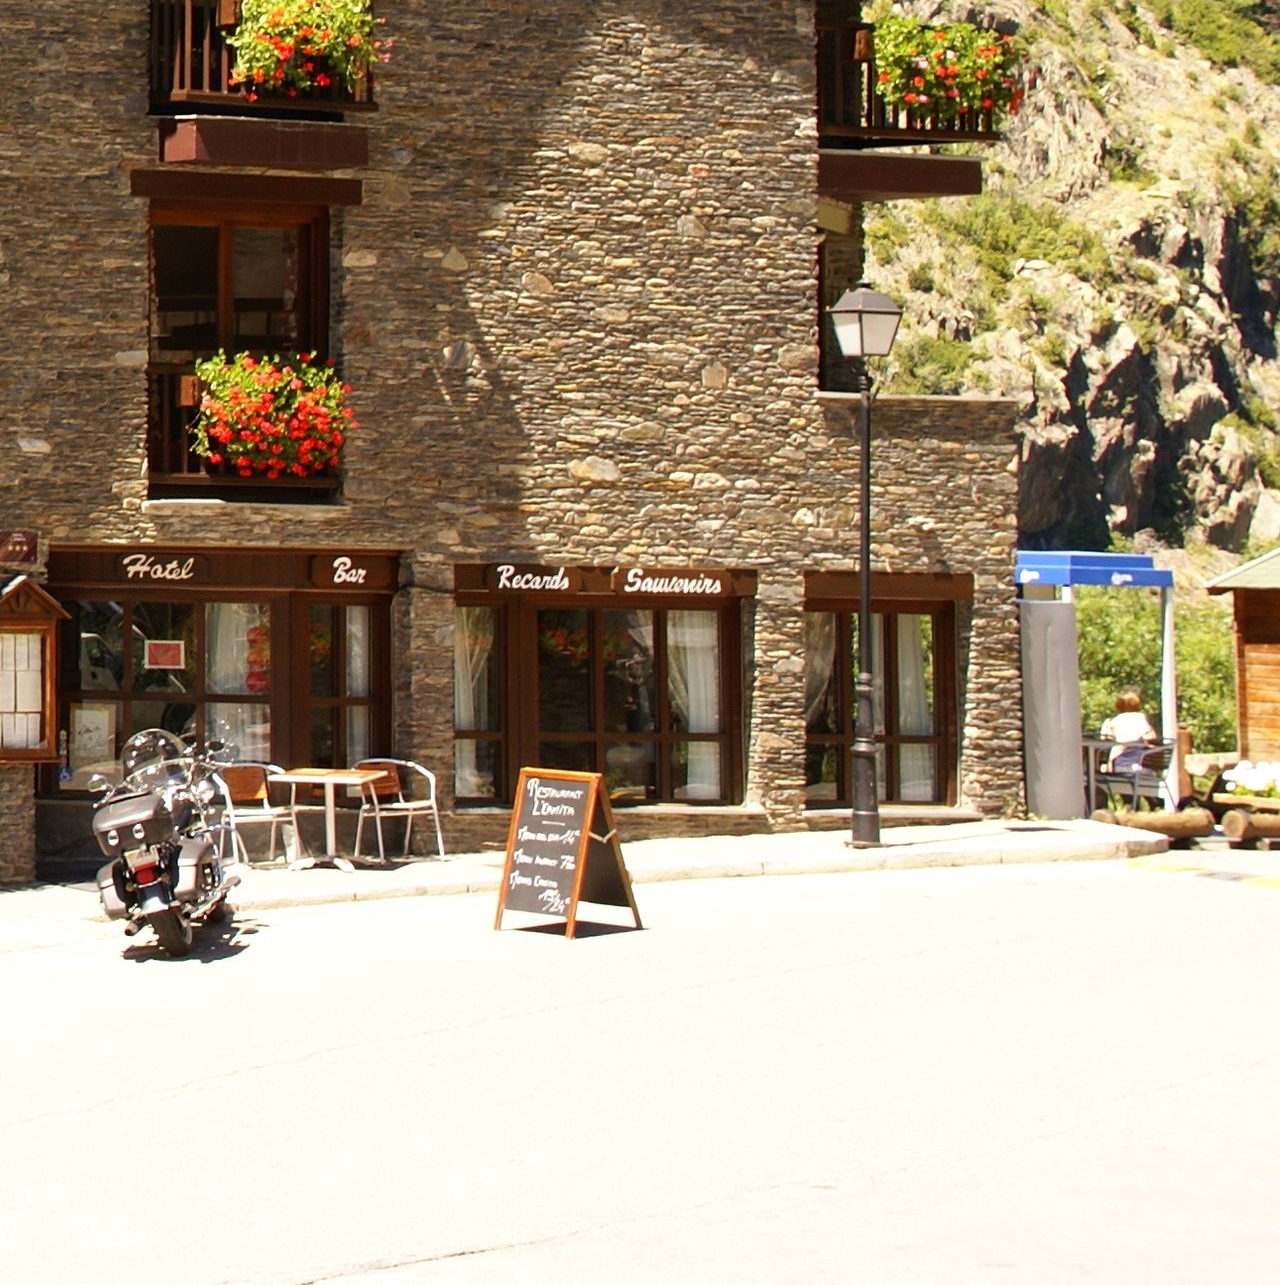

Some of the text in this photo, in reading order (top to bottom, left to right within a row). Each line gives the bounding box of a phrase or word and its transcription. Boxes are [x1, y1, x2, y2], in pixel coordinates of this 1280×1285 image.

[122, 553, 194, 581] Hotel
[333, 556, 367, 584] Bar
[496, 565, 570, 590] Records
[624, 568, 722, 594] Souvenirs
